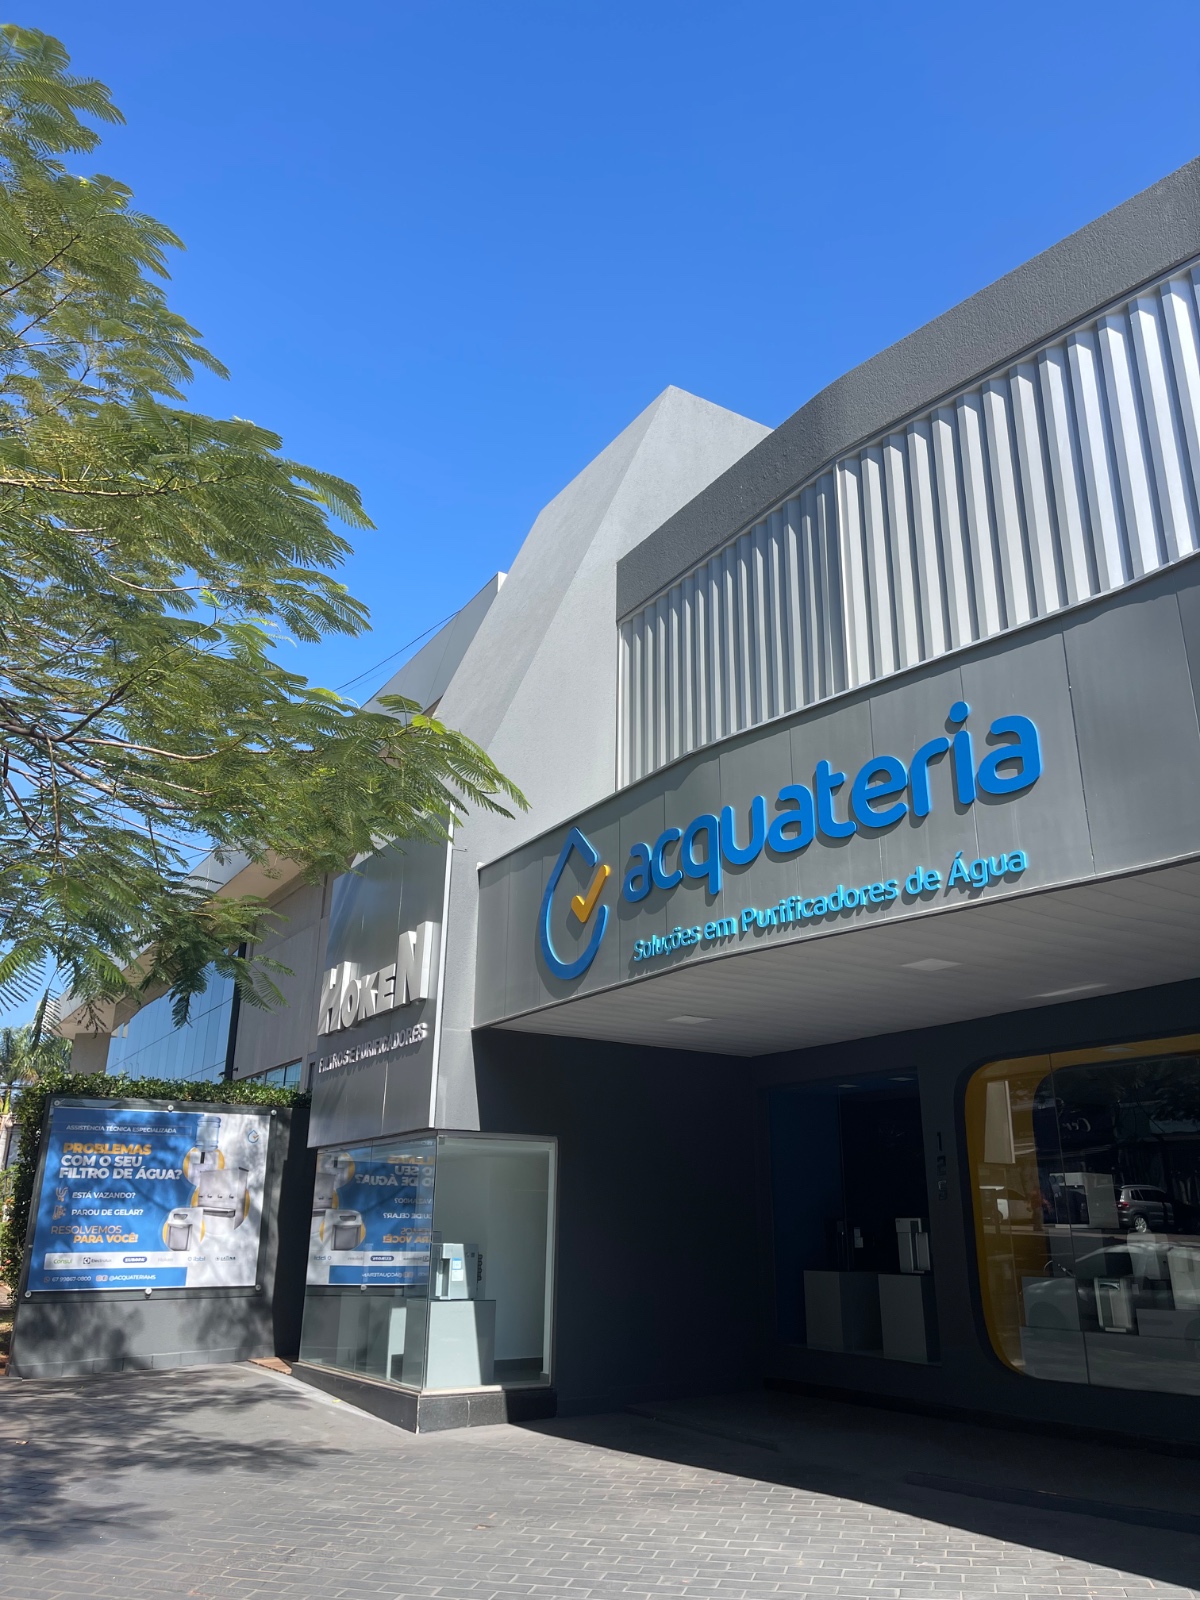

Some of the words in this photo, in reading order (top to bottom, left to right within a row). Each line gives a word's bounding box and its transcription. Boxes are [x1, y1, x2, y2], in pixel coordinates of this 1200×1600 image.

[623, 700, 1042, 902] acquateria
[633, 925, 700, 962] Soluções
[704, 916, 736, 940] em
[741, 877, 898, 932] Purificadores
[905, 865, 940, 896] de
[949, 850, 1029, 890] Água
[356, 1022, 428, 1061] PURIFICADORES
[66, 1124, 105, 1132] ASSISTÊNCIA
[132, 1126, 177, 1134] ESPECIALIZADA
[63, 1142, 152, 1155] PROBLEMAS
[61, 1155, 95, 1167] COM
[99, 1156, 111, 1167] O
[114, 1156, 142, 1167] SEU
[59, 1167, 110, 1179] FILTRO
[112, 1168, 133, 1179] DE
[135, 1166, 183, 1180] ÁGUA?
[72, 1189, 92, 1199] ESTÁ
[93, 1191, 136, 1199] VAZANDO?
[71, 1208, 100, 1217] PAROU
[101, 1208, 112, 1216] DE
[113, 1208, 144, 1217] GELAR?
[51, 1225, 122, 1235] RESOLVEMOS
[73, 1234, 103, 1244] PARA
[106, 1231, 139, 1244] VOCÊ!
